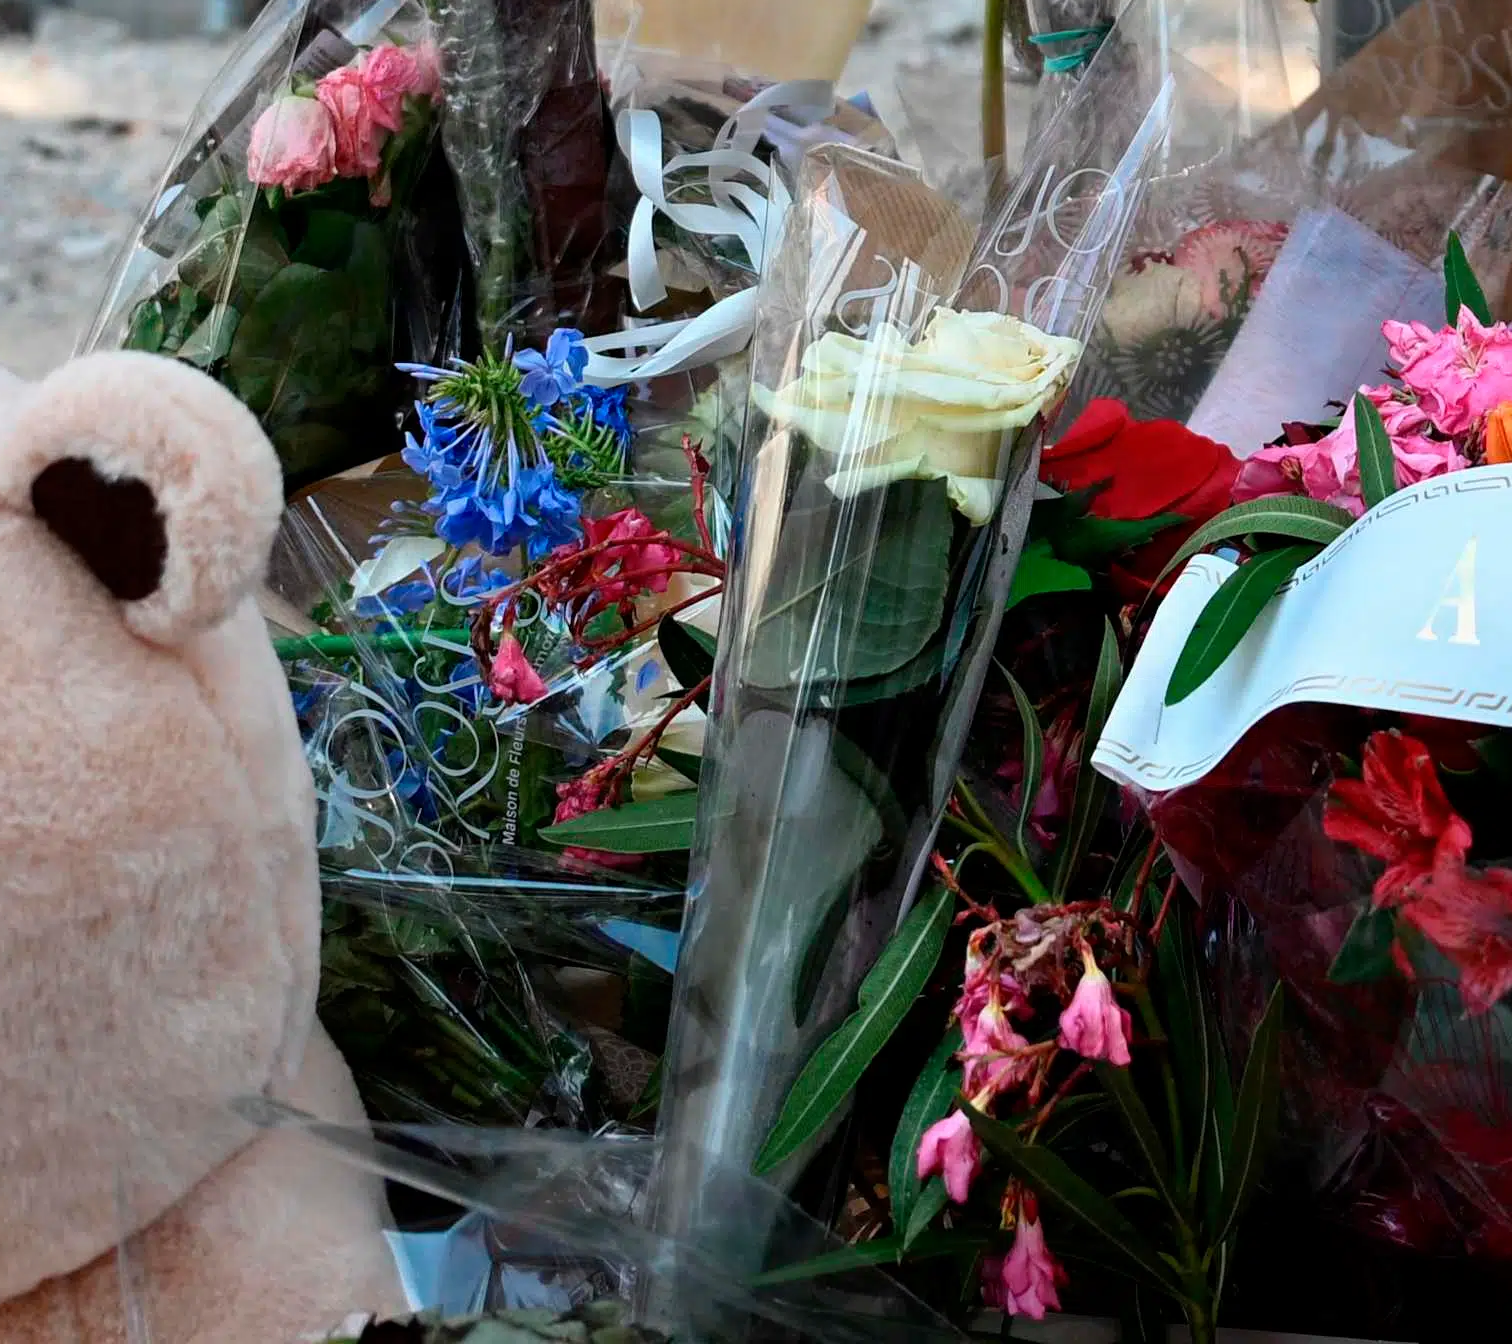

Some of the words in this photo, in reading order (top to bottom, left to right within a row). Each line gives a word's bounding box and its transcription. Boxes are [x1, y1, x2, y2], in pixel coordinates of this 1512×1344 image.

[1416, 534, 1480, 646] A
[511, 716, 528, 766] Fleurs
[507, 766, 520, 790] de
[502, 792, 519, 846] Maison
